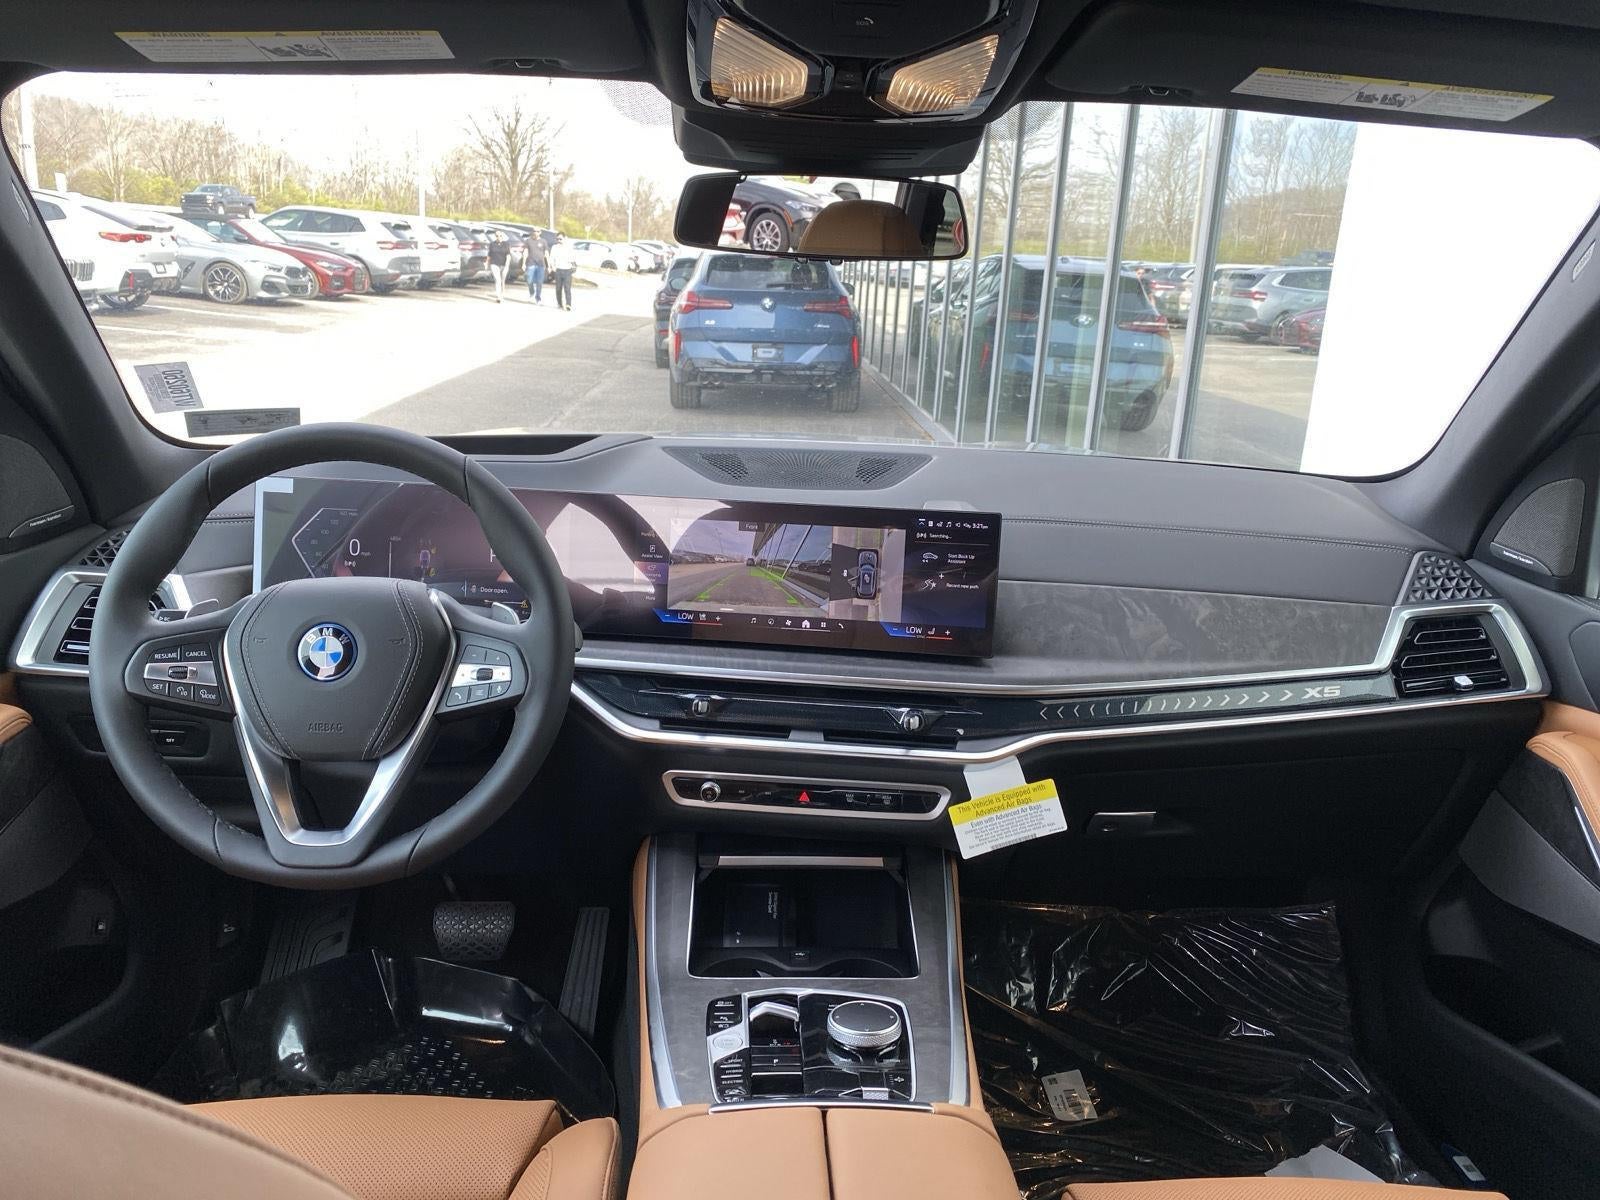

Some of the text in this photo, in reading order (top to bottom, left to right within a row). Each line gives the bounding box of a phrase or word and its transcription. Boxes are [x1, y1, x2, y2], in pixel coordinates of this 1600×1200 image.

[1288, 70, 1342, 80] WARNING
[350, 538, 360, 556] 0
[306, 628, 350, 644] BMW
[1302, 686, 1340, 699] X5
[308, 722, 344, 733] AIRBAG
[957, 805, 971, 814] This
[971, 798, 994, 810] Vehicle
[1002, 788, 1030, 801] Equipped
[1032, 784, 1046, 793] with
[975, 797, 1032, 817] Advanced Air Bags
[995, 809, 1020, 820] Advanced
